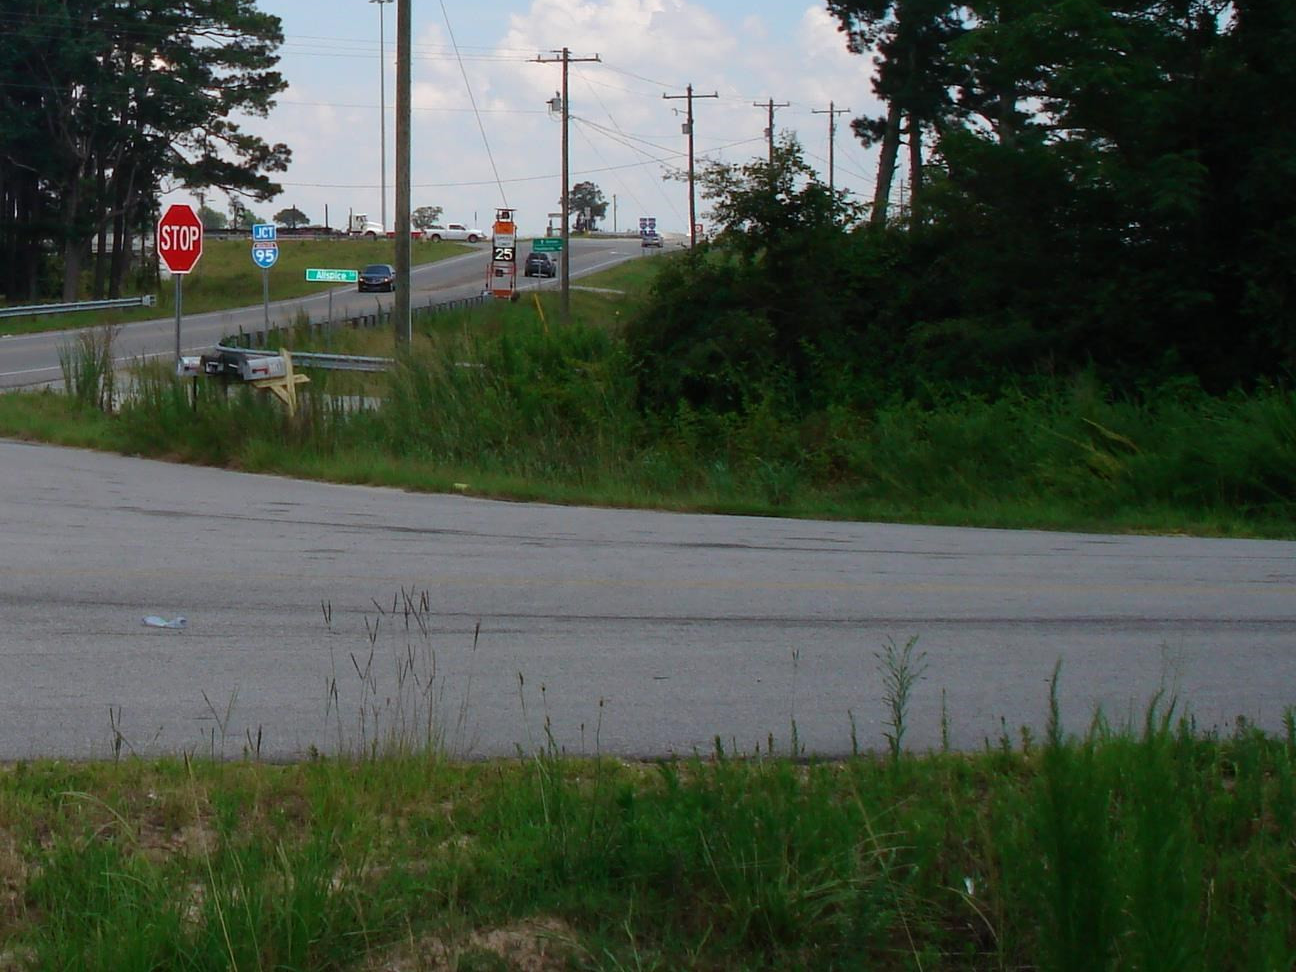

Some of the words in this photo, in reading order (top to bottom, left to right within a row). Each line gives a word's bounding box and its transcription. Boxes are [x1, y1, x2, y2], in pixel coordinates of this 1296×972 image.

[161, 225, 199, 250] STOP
[256, 227, 273, 238] JCT
[256, 250, 274, 262] 95
[495, 248, 513, 260] 25
